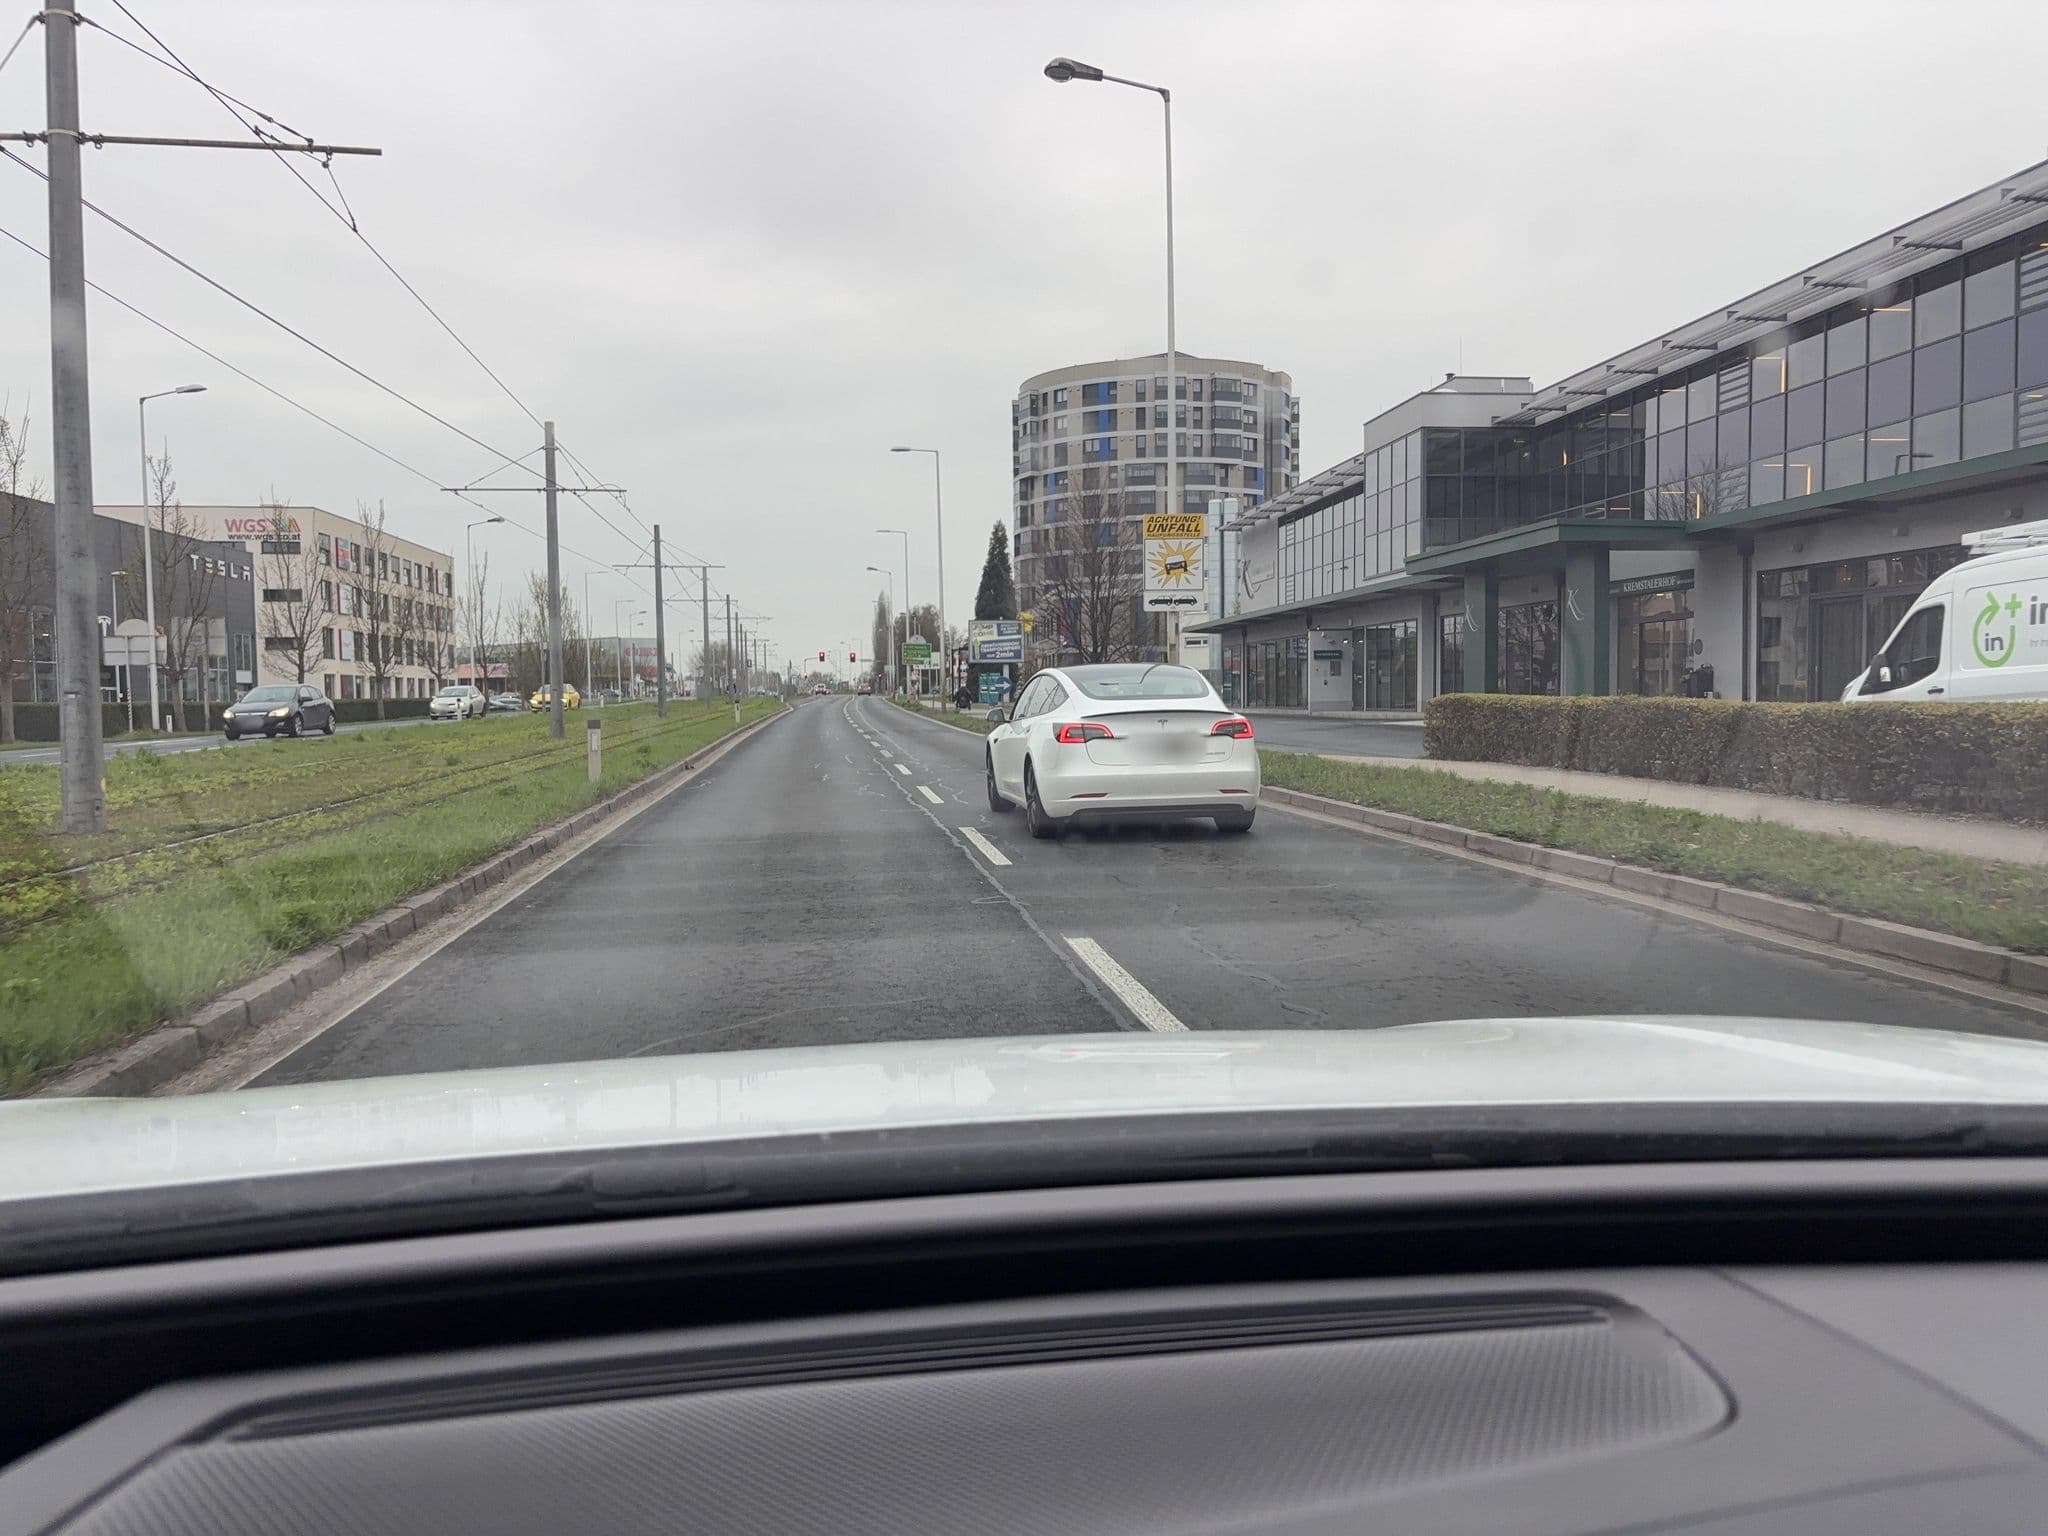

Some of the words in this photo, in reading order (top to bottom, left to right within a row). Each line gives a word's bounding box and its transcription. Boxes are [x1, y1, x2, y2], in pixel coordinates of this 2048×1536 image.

[225, 518, 266, 533] WGS
[1148, 515, 1201, 523] ACHTUNG!
[1147, 523, 1201, 532] UNFALL
[190, 554, 251, 581] TESLA
[1623, 575, 1677, 593] KREMSTALERHOF
[1985, 632, 2004, 652] in
